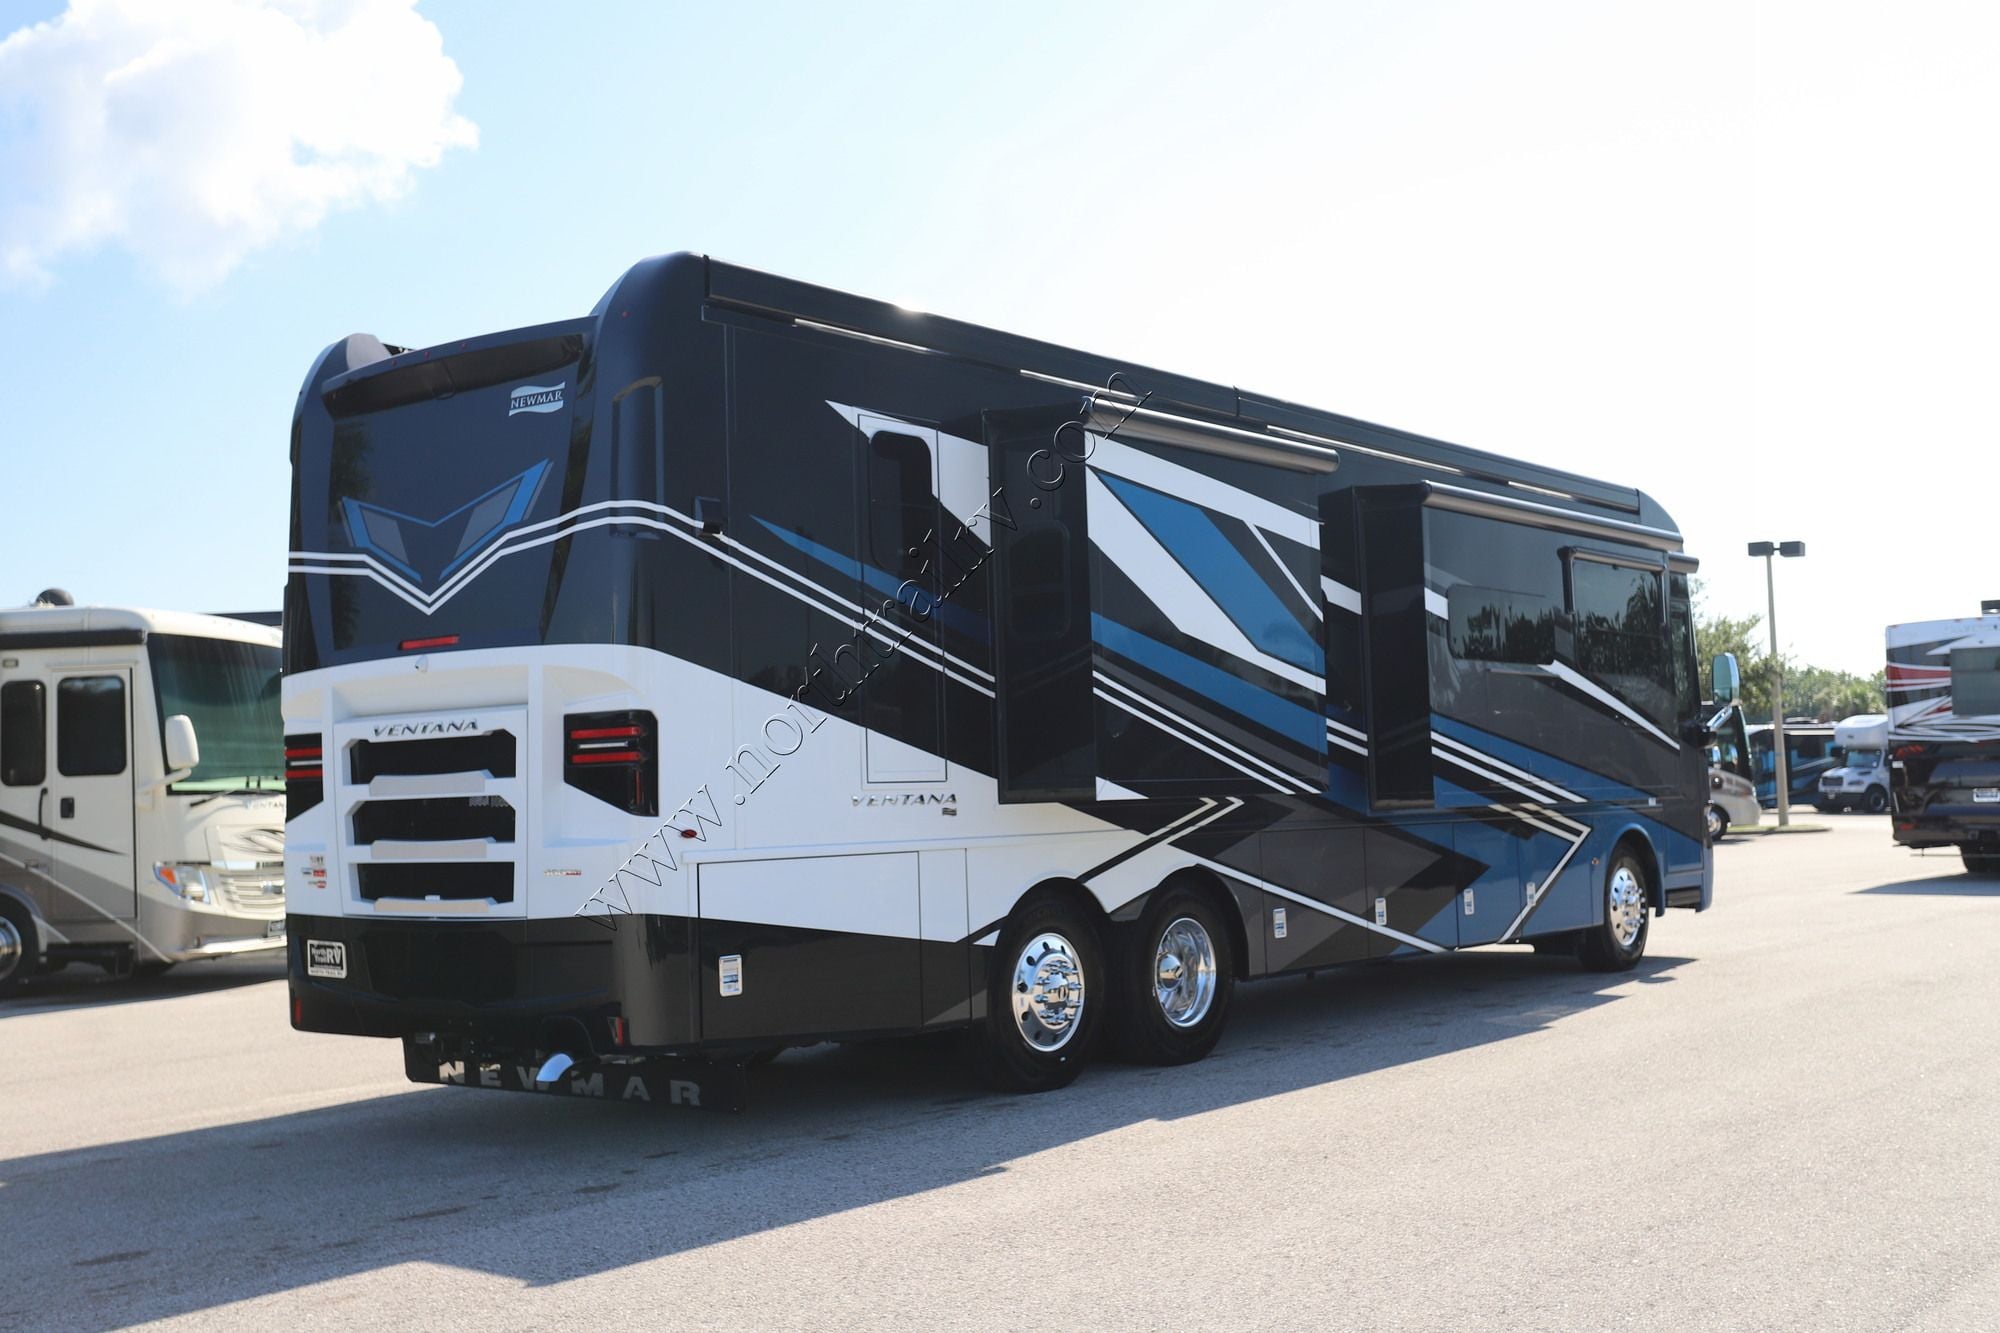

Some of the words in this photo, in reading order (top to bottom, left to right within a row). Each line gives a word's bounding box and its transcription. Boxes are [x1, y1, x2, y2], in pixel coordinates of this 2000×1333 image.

[510, 390, 563, 409] NEWMAR
[374, 720, 478, 737] VENTANA
[851, 793, 957, 807] VENTANA
[326, 947, 342, 965] RV
